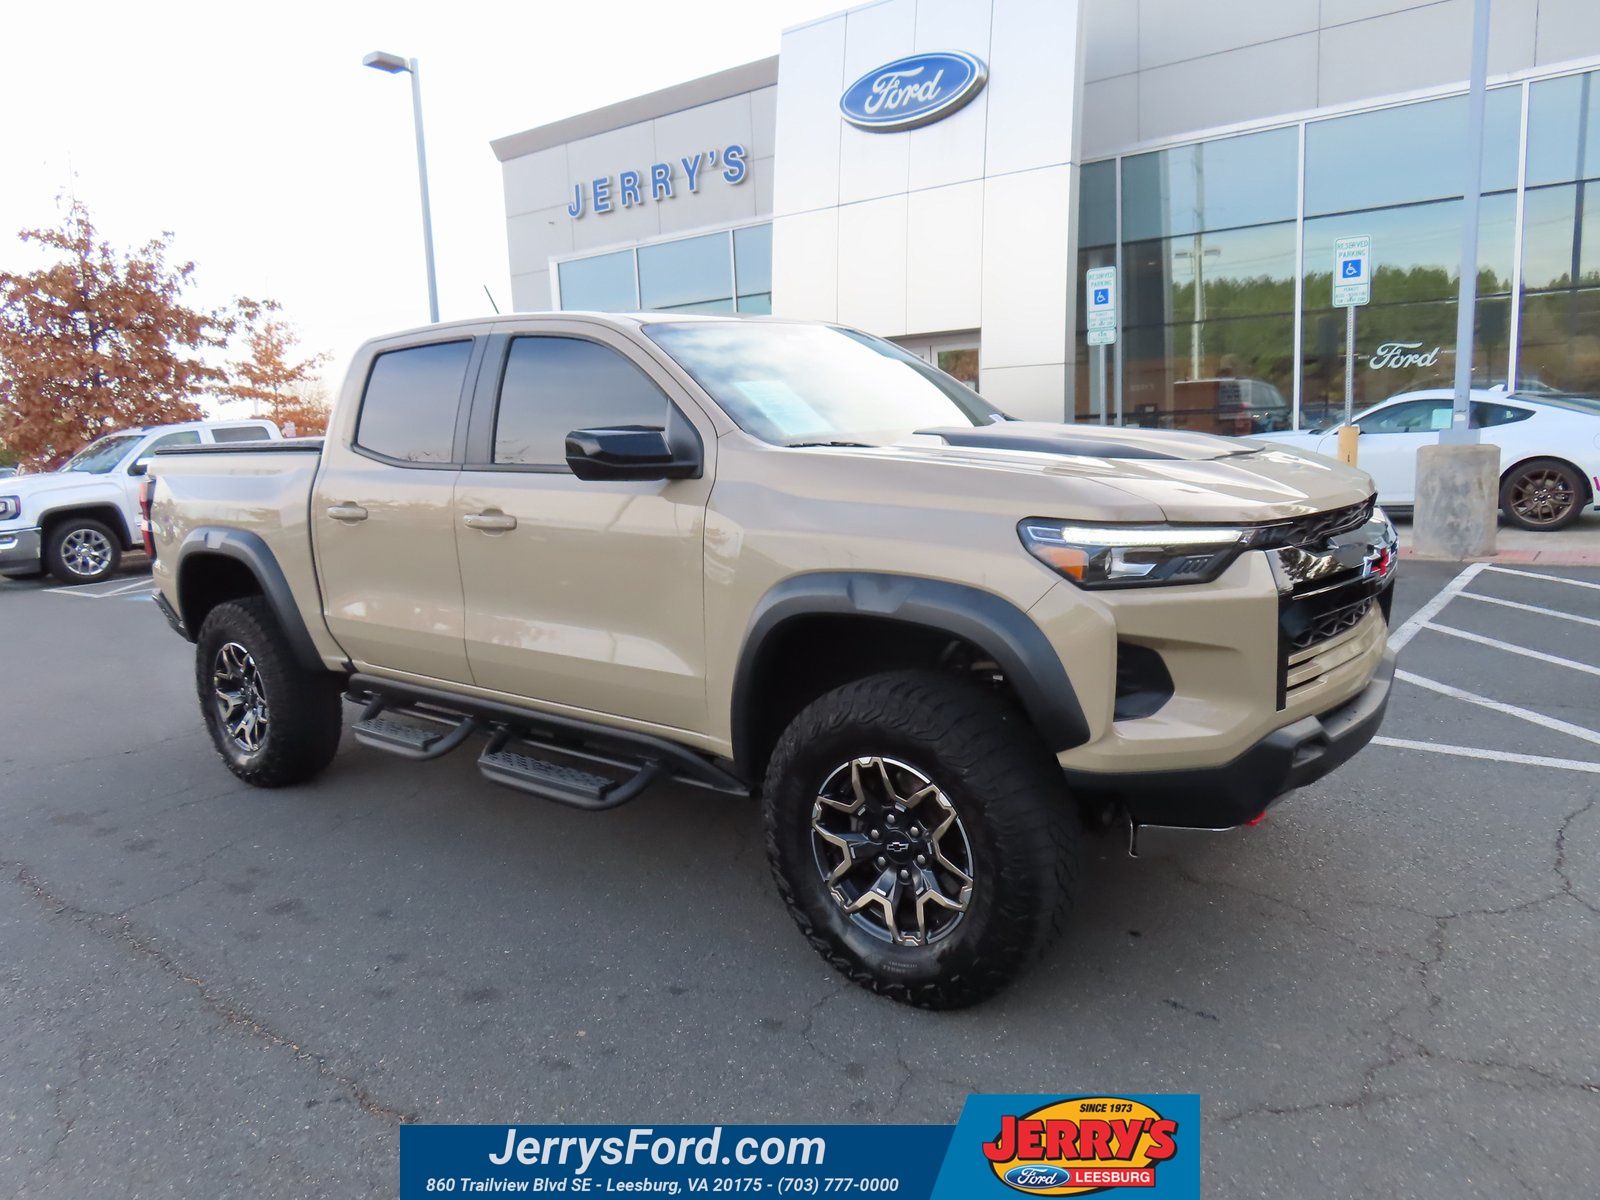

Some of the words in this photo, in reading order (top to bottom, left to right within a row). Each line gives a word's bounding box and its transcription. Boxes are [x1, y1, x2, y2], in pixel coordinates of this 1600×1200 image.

[865, 66, 945, 114] Ford
[568, 143, 748, 219] JERRY'S
[1338, 249, 1366, 258] PARKING
[1369, 342, 1440, 370] Ford
